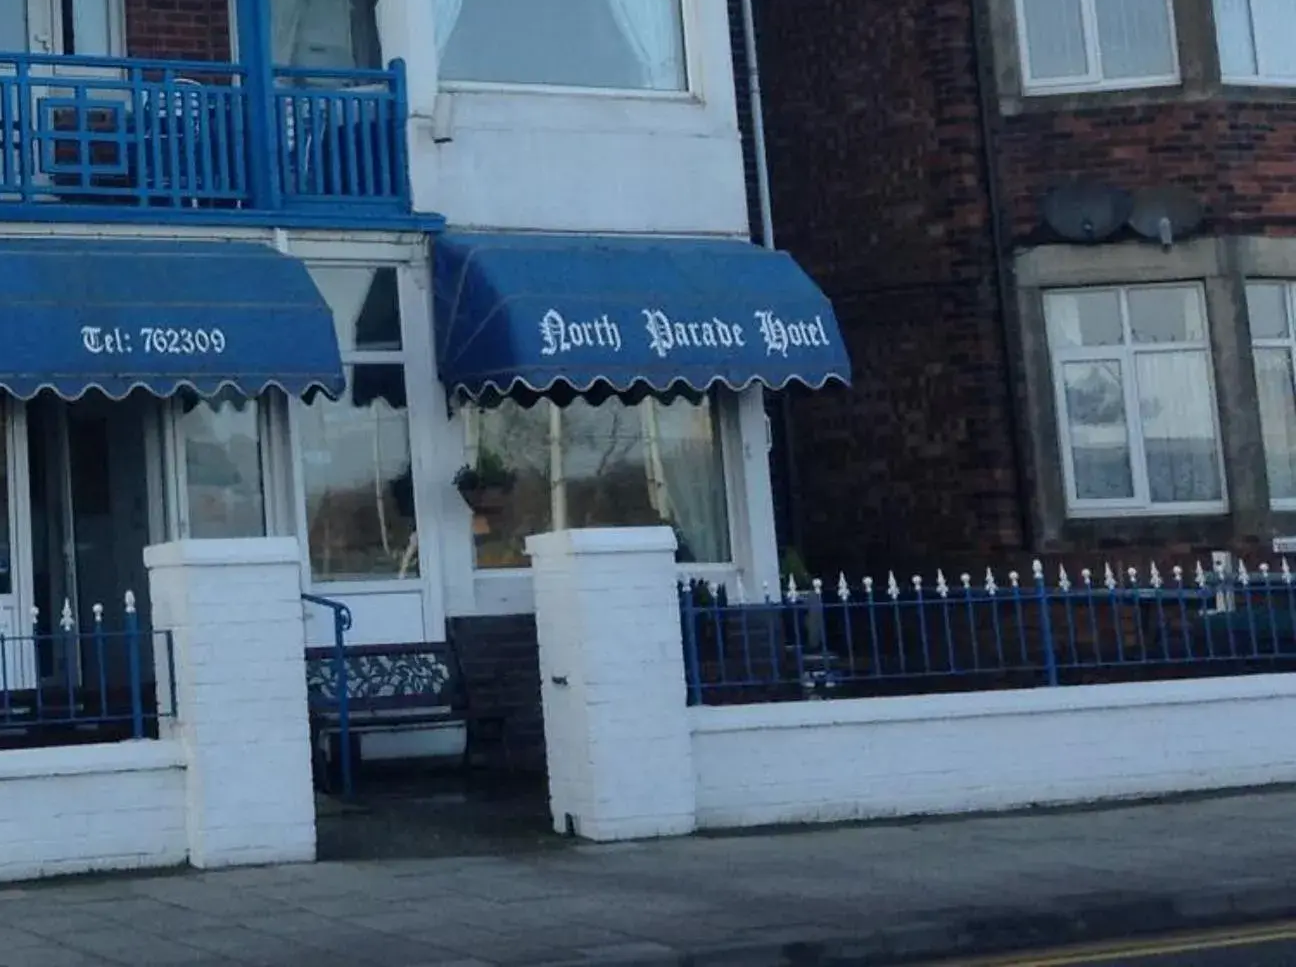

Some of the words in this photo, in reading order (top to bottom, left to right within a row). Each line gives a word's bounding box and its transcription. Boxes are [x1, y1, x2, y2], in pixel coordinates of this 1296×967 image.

[80, 325, 133, 355] Tel:
[139, 327, 227, 355] 762309
[538, 308, 622, 357] North
[642, 308, 746, 358] Parade
[754, 308, 831, 358] Hotel
